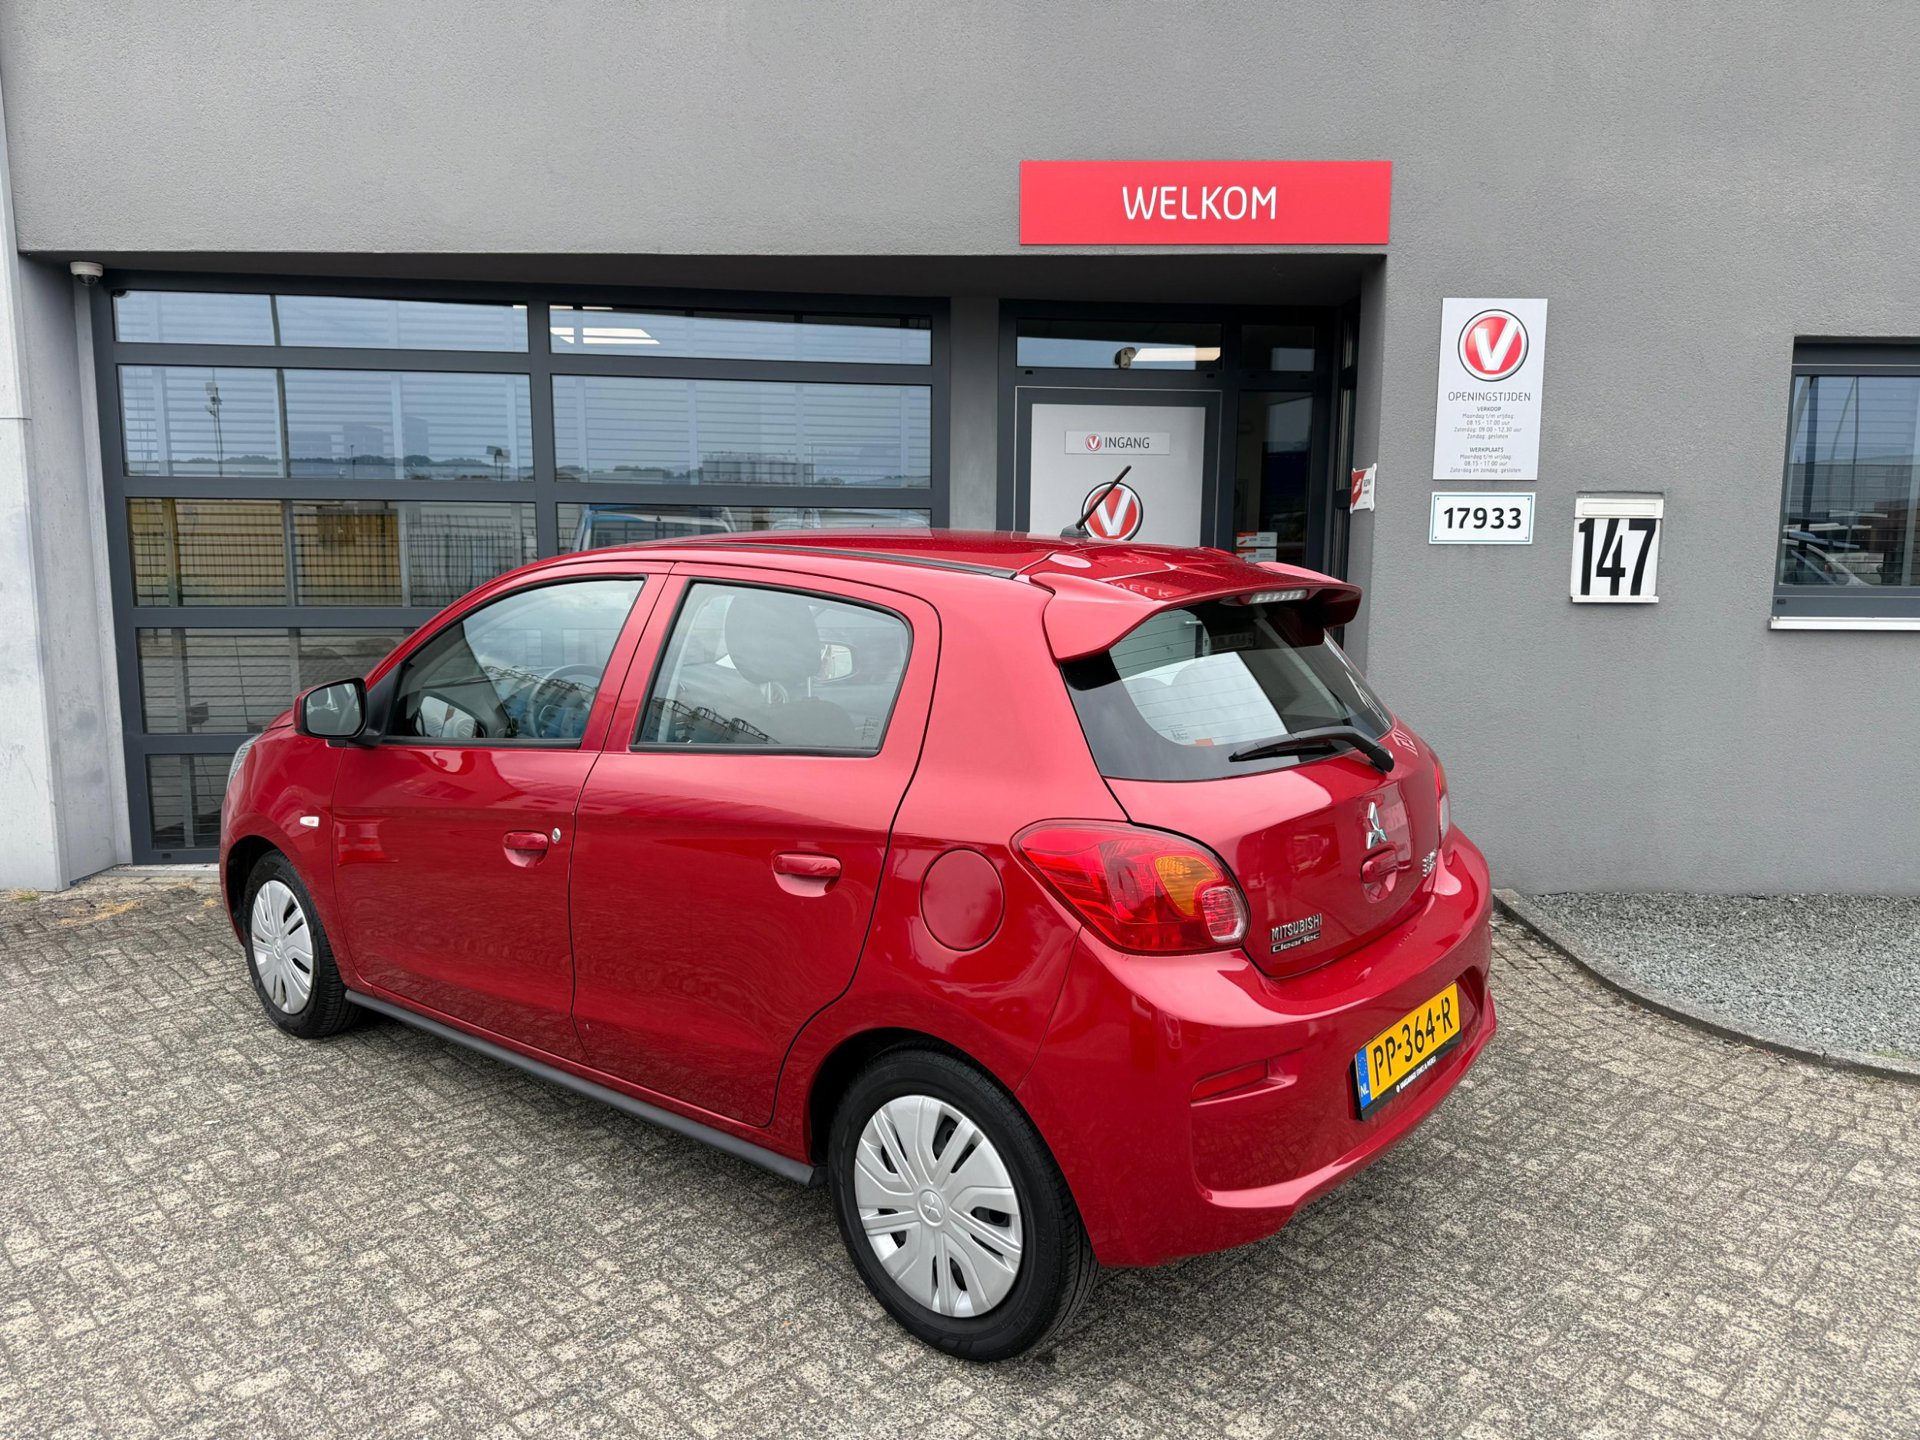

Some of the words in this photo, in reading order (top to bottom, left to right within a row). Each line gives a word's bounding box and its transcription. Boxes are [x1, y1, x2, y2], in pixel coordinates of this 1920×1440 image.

[1122, 185, 1278, 221] WELKOM
[1447, 391, 1532, 402] OPENINGSTIJDEN
[1104, 437, 1150, 449] INGANG
[1443, 507, 1522, 529] 17933
[1578, 518, 1657, 596] 147
[1271, 912, 1323, 942] MITSUBISHI
[1272, 932, 1320, 953] ClearTec
[1373, 996, 1453, 1087] PP-364-R
[1360, 1082, 1369, 1097] NL
